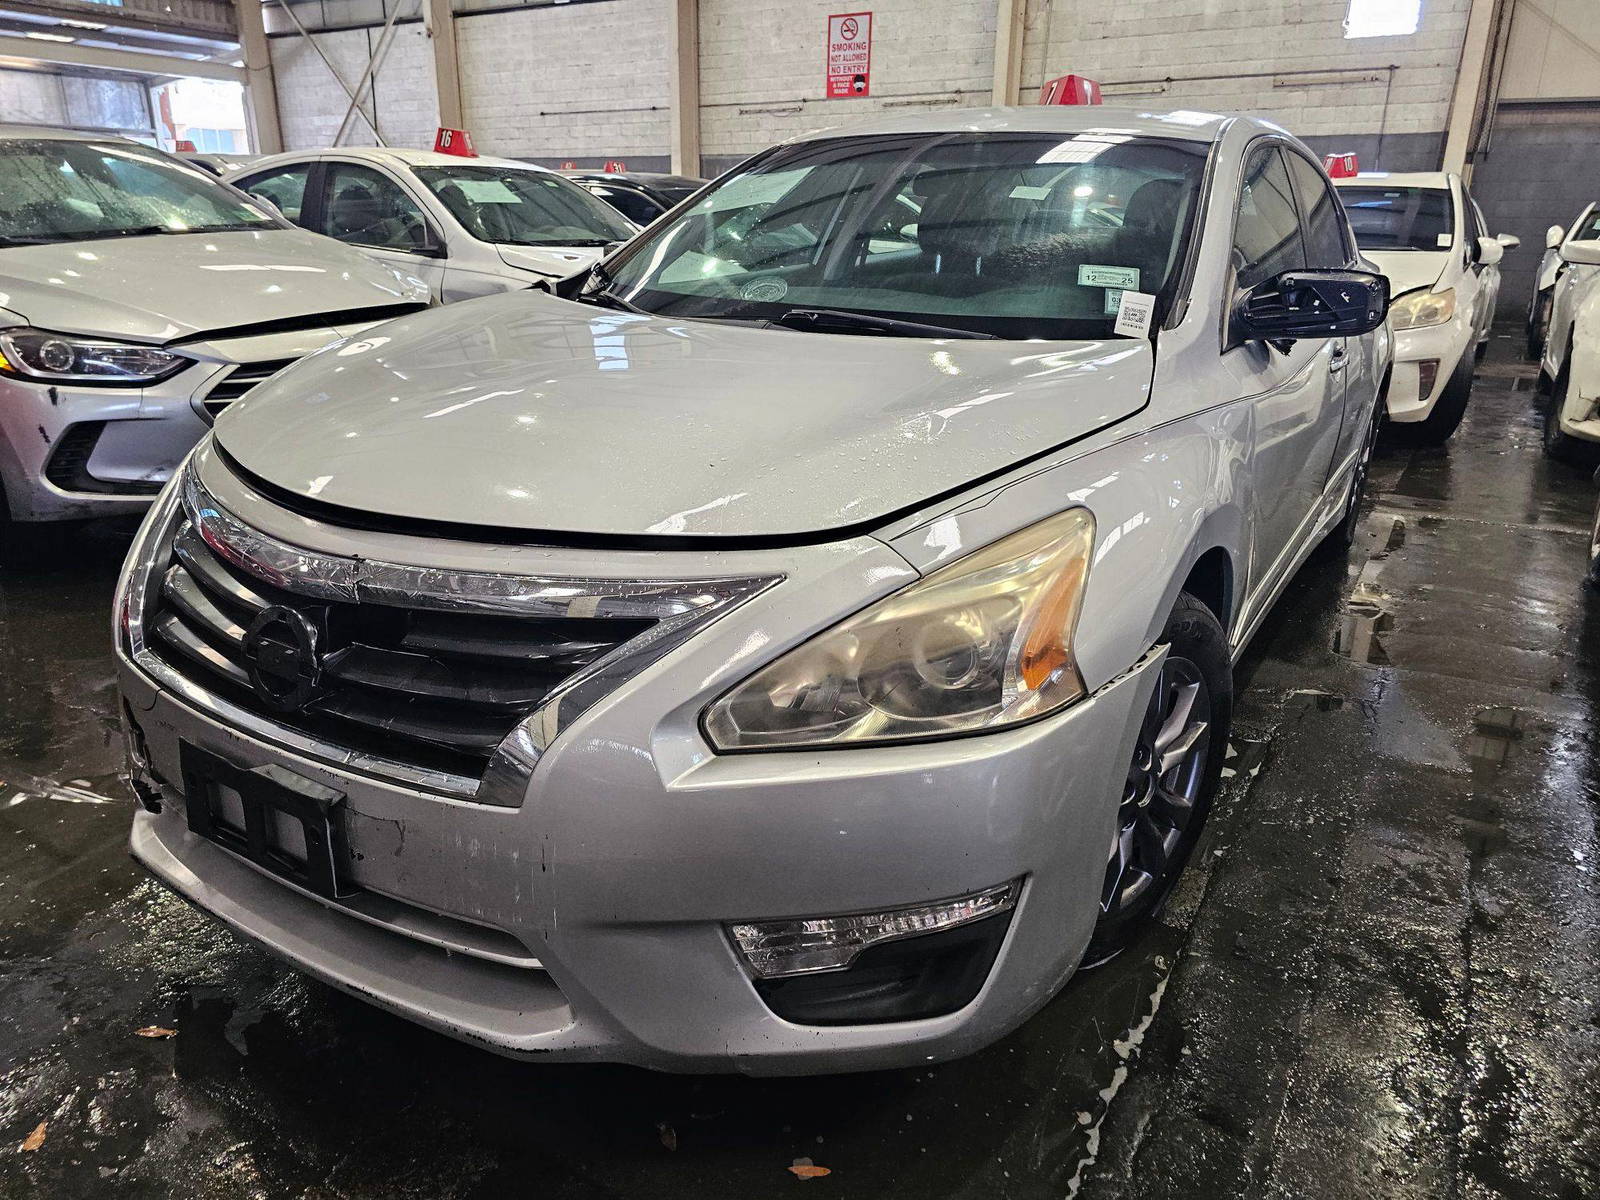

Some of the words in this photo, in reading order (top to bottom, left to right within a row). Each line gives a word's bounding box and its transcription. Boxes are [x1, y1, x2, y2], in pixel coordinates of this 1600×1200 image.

[832, 42, 866, 52] SMOKING
[831, 54, 842, 62] NOT
[843, 53, 867, 62] ALLOWED
[831, 66, 841, 74] NO
[843, 65, 865, 73] ENTRY
[440, 130, 453, 148] 16
[1344, 156, 1353, 172] 10
